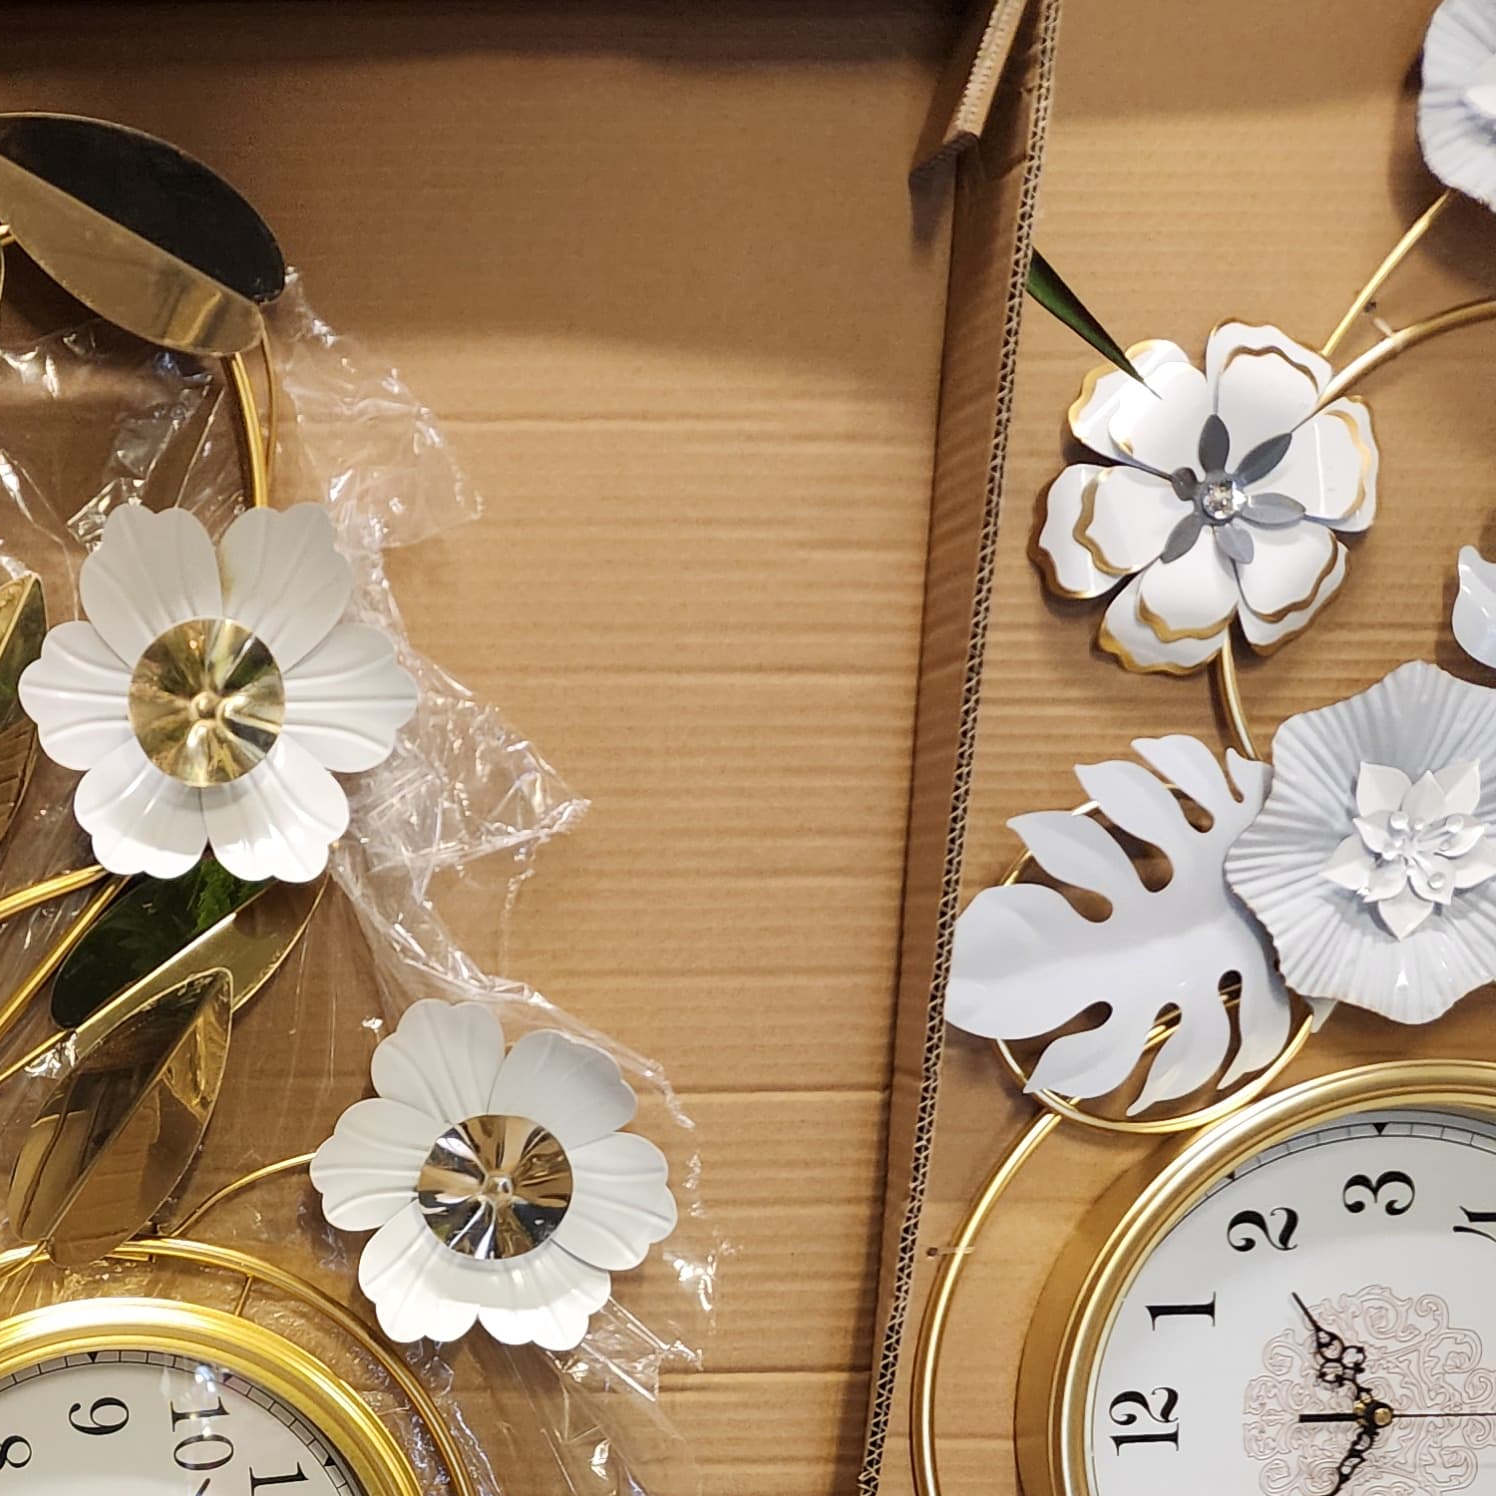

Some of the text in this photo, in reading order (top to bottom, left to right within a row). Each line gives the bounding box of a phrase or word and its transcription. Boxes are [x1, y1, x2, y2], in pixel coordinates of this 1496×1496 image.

[1342, 1170, 1415, 1216] 3
[1227, 1207, 1298, 1252] 2
[1145, 1291, 1216, 1331] 1
[69, 1397, 129, 1435] 9
[170, 1396, 234, 1471] 10
[1109, 1386, 1179, 1456] 12
